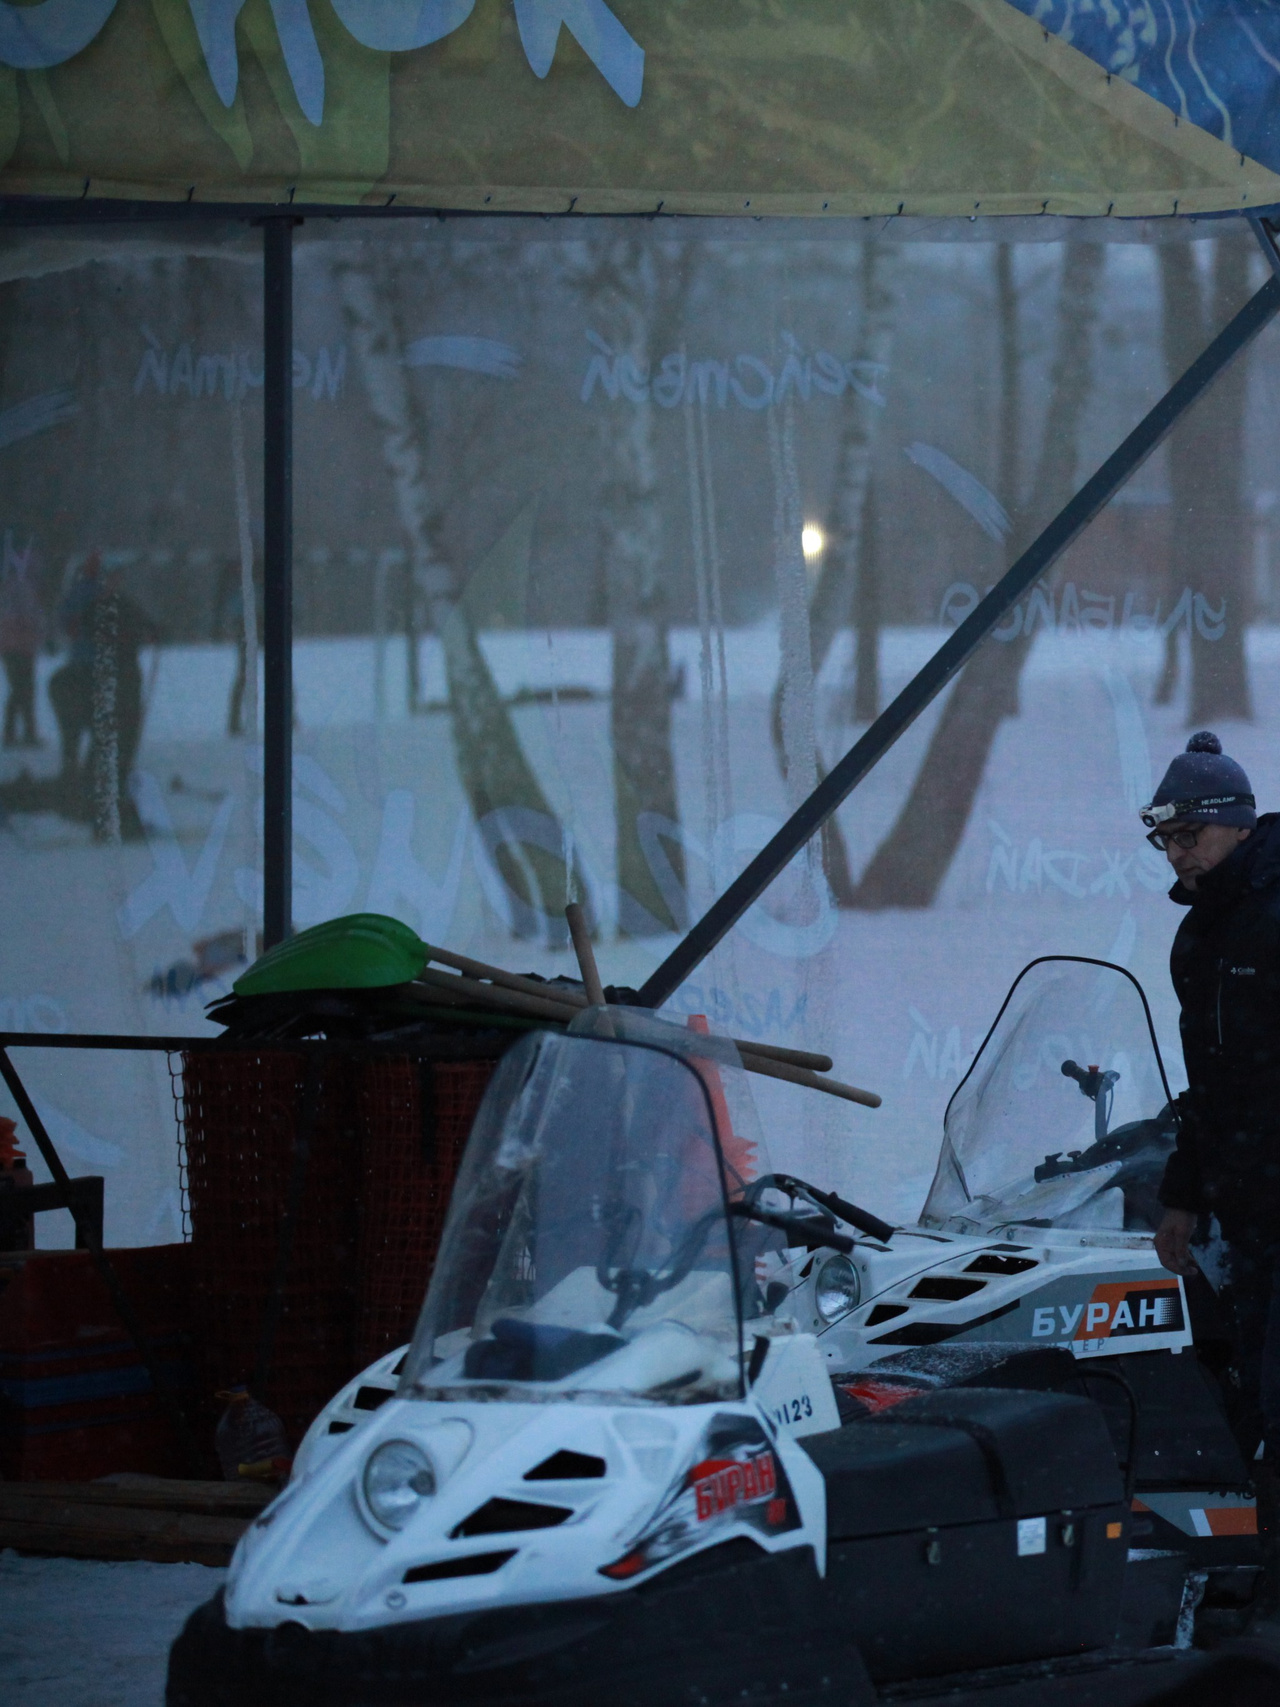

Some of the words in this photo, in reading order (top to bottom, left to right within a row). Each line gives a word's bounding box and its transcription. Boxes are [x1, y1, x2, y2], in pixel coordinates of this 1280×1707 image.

[1201, 796, 1236, 805] HEADLAMP
[1031, 1297, 1169, 1338] БУРАН
[695, 1453, 775, 1521] БУРАН
